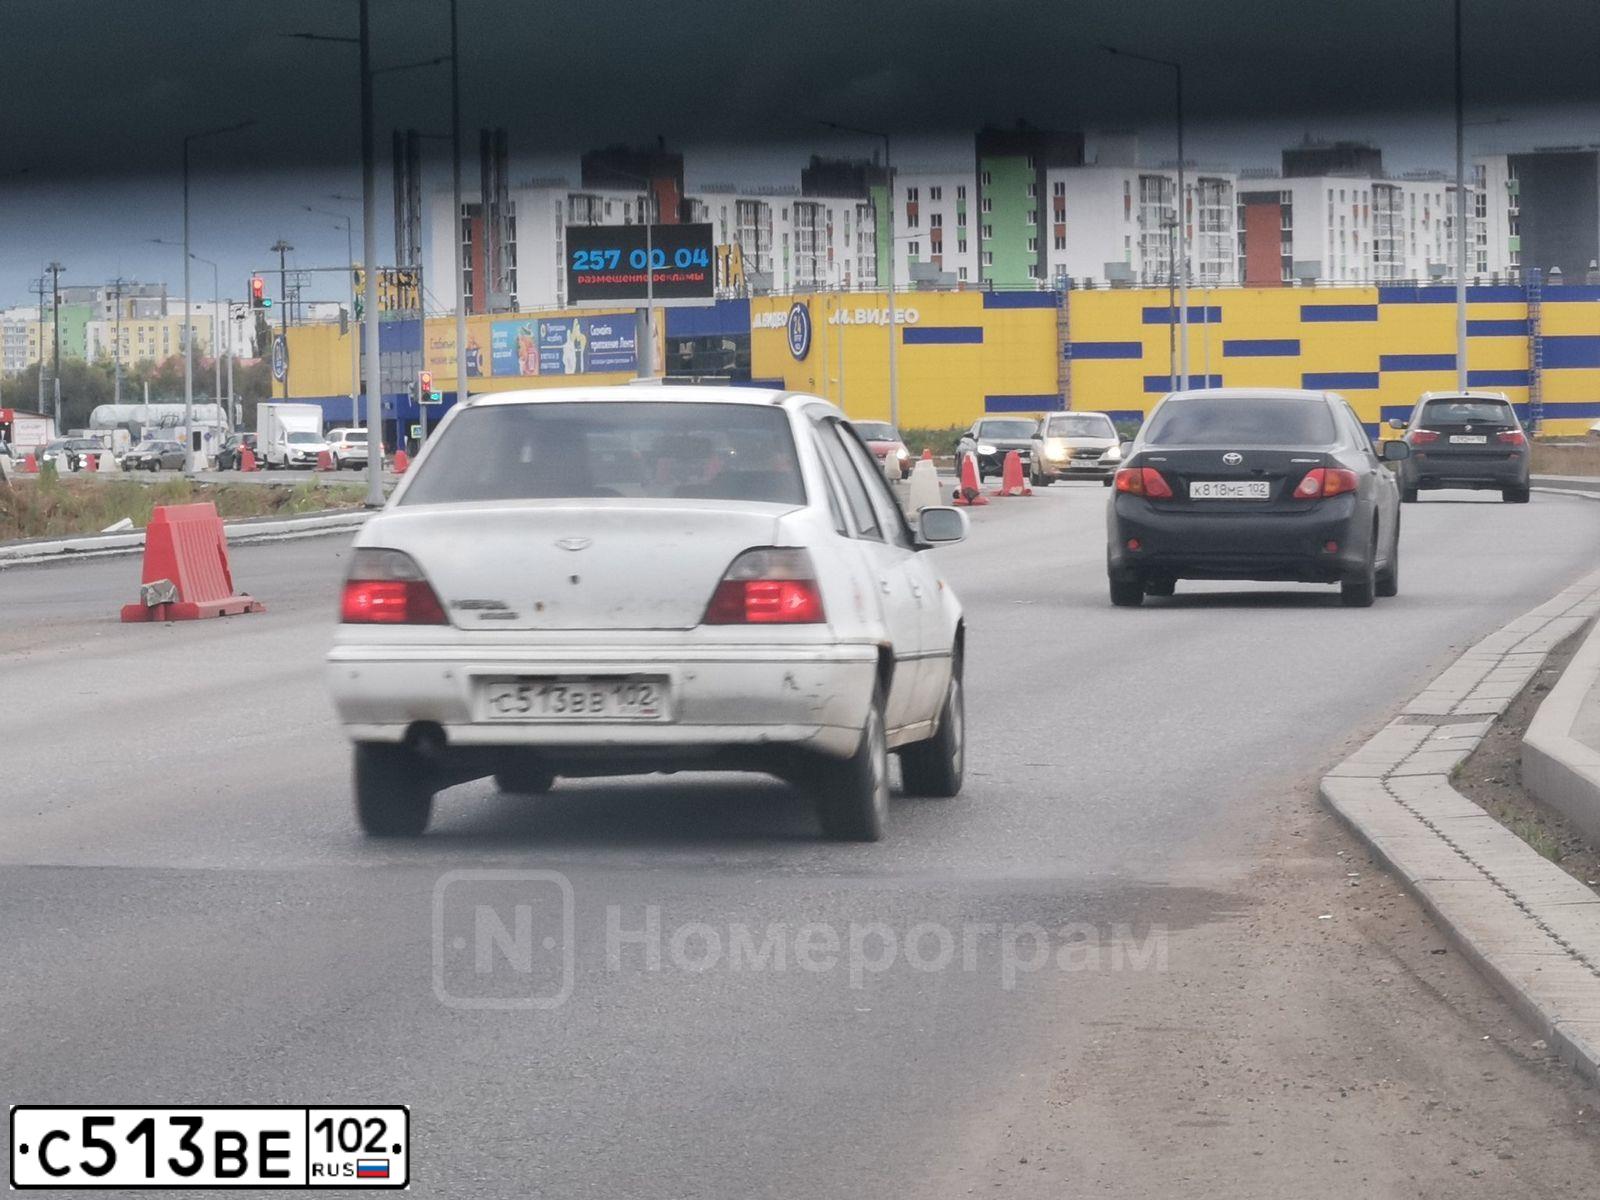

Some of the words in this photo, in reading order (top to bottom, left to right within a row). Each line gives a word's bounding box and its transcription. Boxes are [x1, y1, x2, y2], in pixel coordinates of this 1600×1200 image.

[572, 250, 621, 271] 257
[629, 249, 666, 270] 00
[674, 248, 709, 268] 04
[828, 308, 919, 326] М.ВИДЕО
